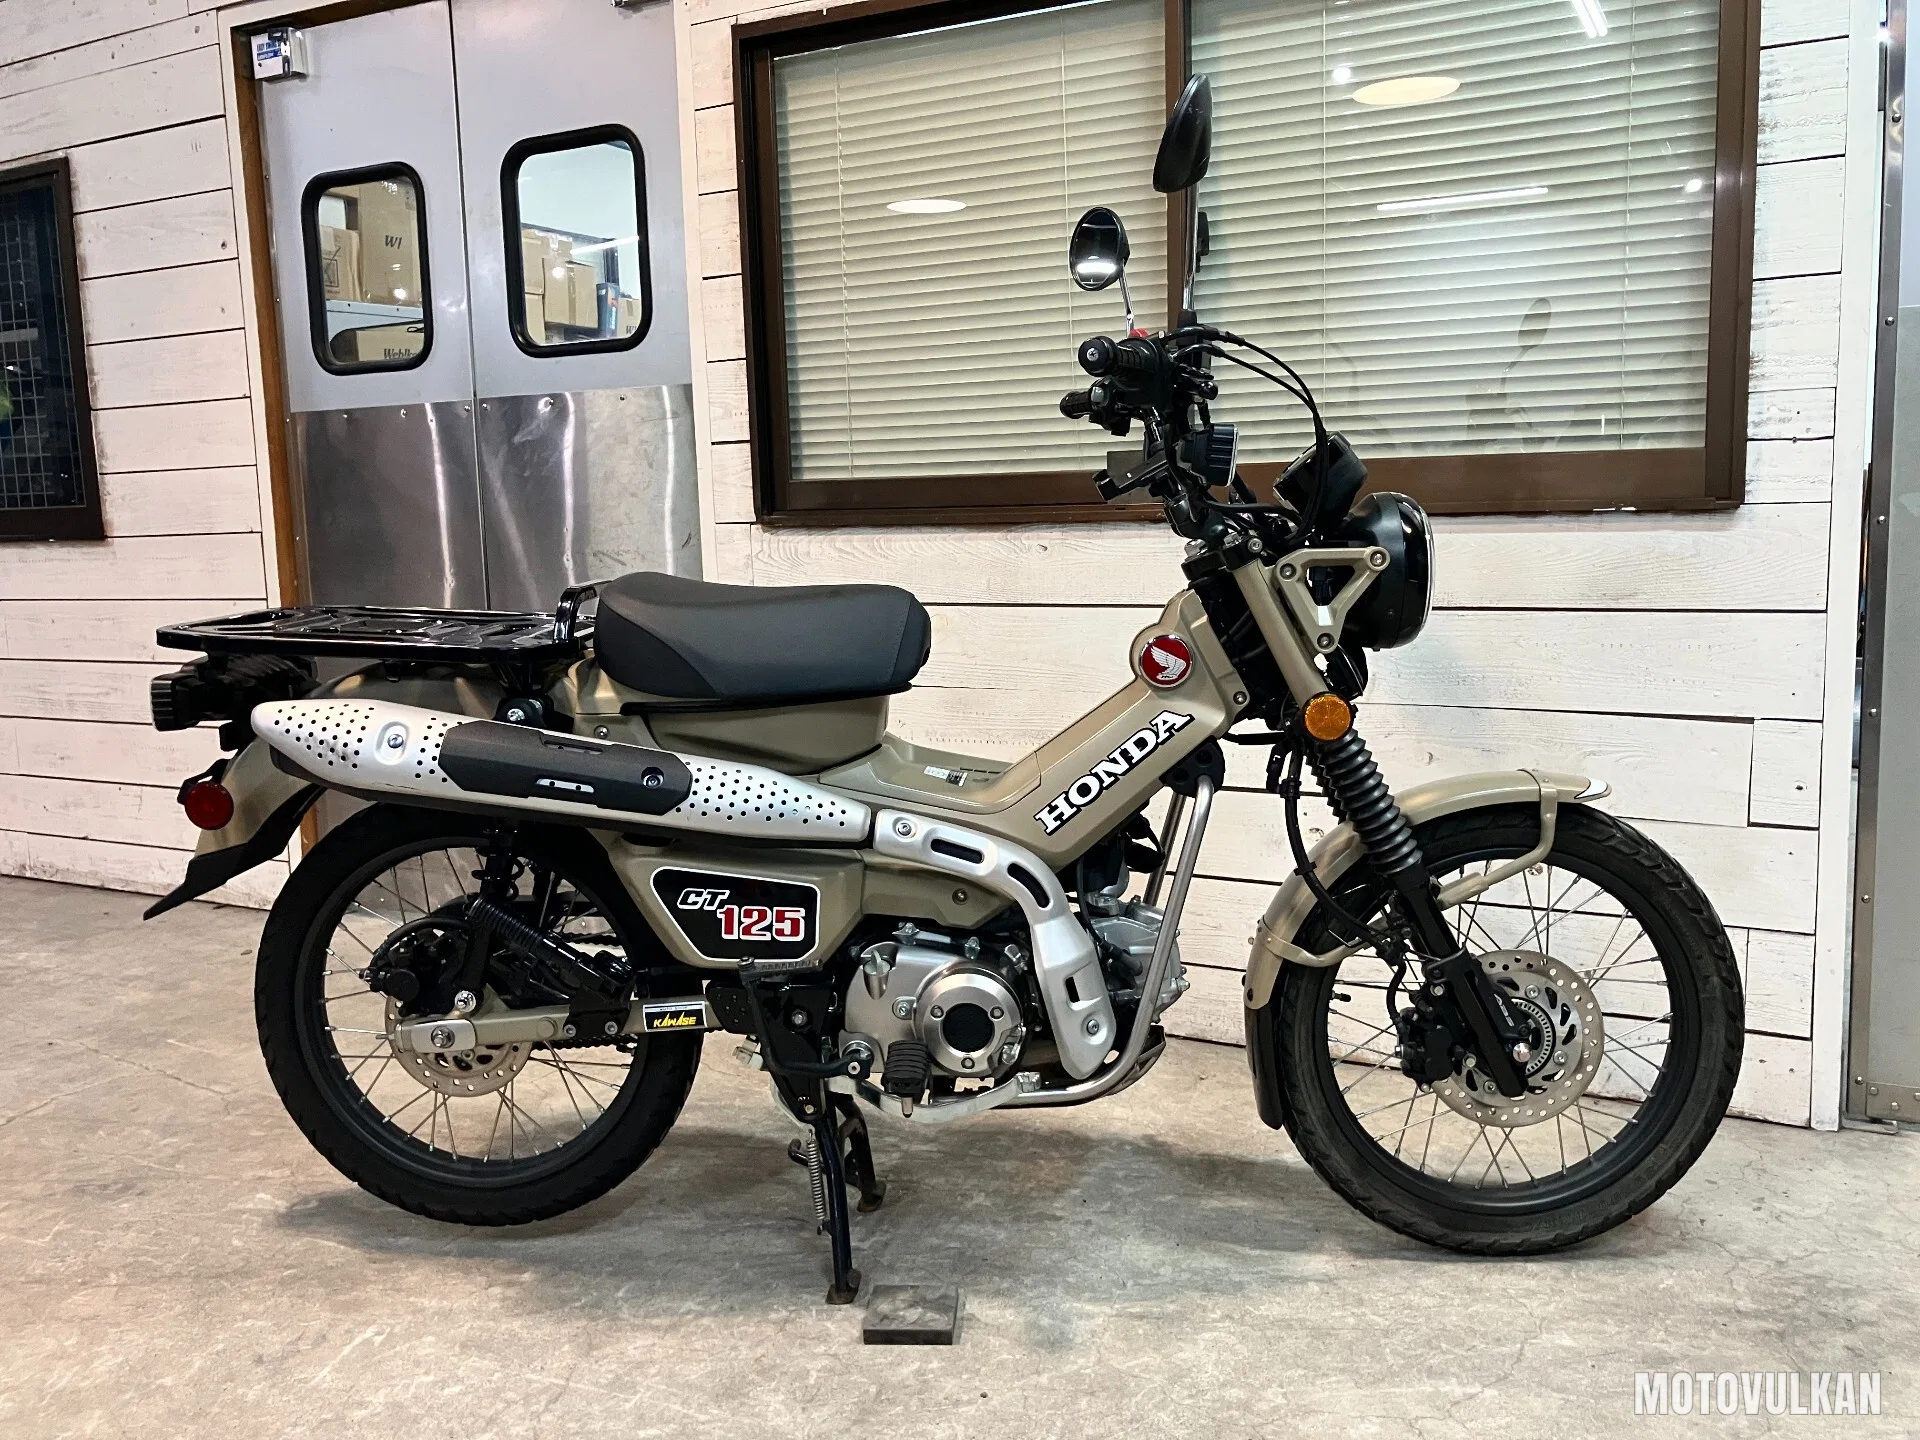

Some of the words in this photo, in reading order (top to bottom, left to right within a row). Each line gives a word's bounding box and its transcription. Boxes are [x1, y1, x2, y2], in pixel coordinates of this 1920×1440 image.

[1033, 710, 1195, 835] HONDA
[677, 888, 730, 910] CT
[717, 905, 805, 941] 125
[653, 1011, 696, 1028] KAWASE
